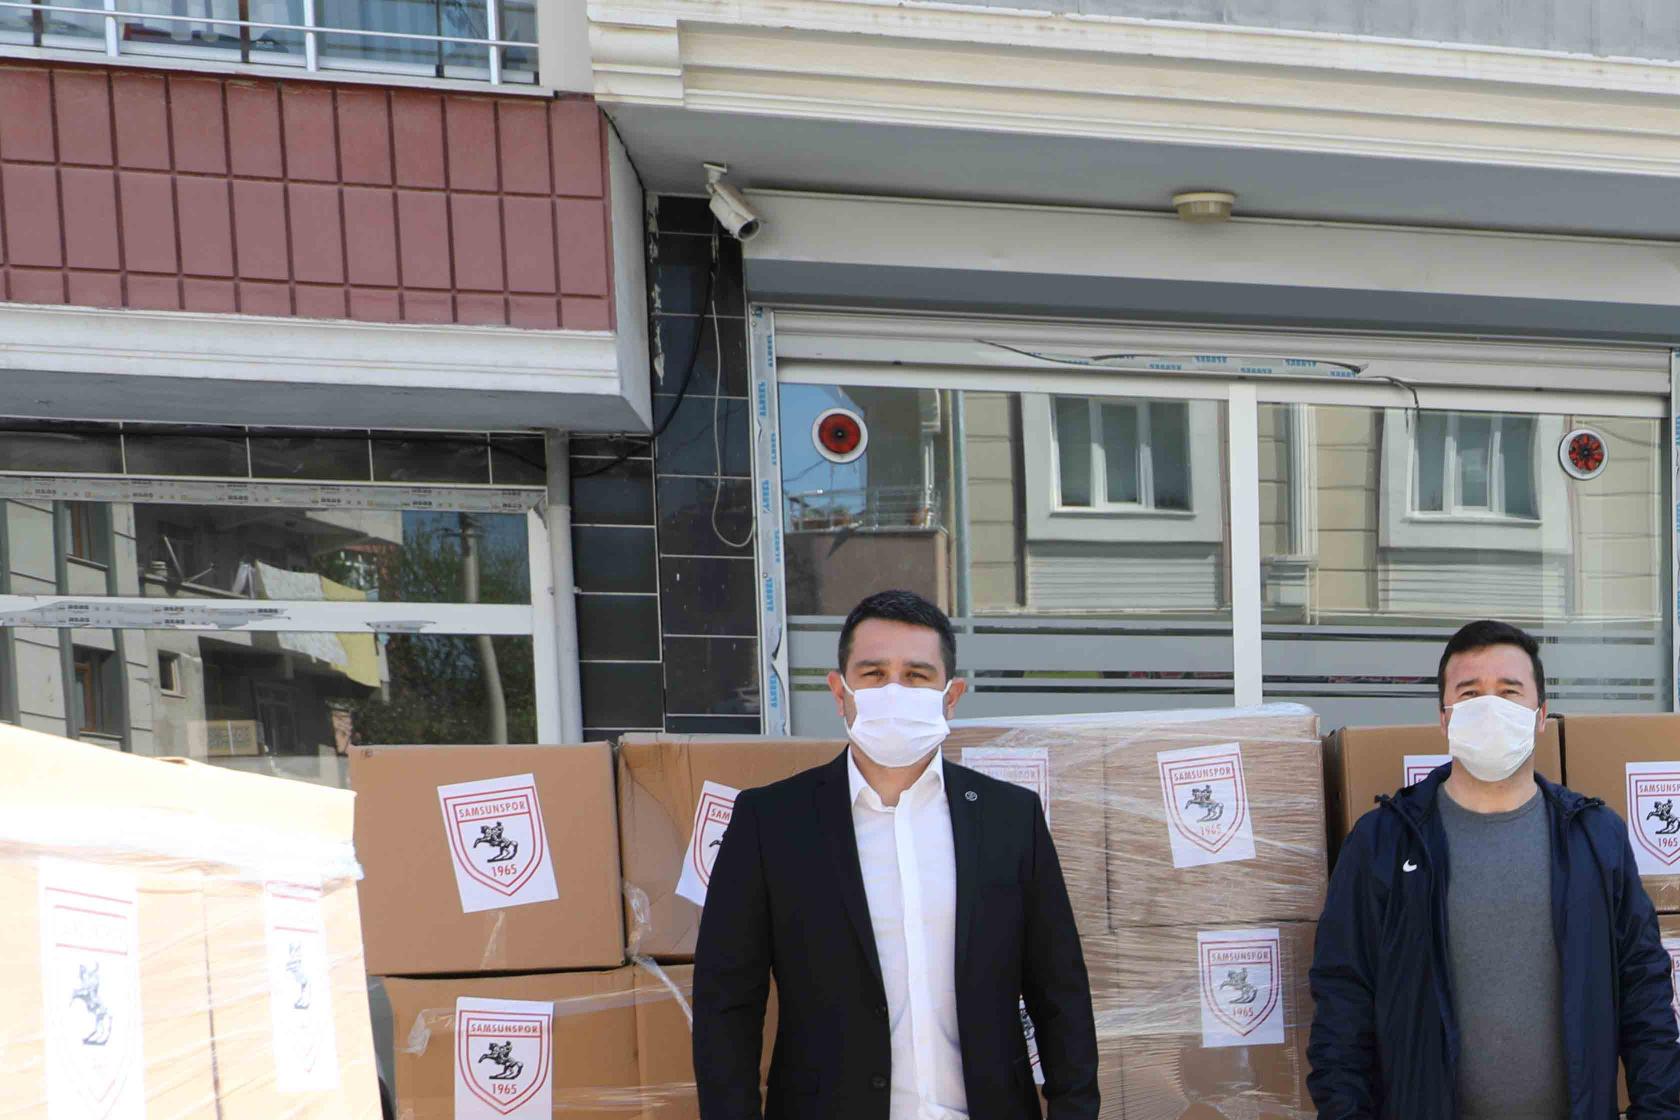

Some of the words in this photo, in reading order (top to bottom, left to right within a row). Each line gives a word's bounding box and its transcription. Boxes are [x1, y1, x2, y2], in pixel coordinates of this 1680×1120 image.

[1174, 766, 1231, 782] SAMSUNSPOR
[458, 801, 526, 819] SAMSUNSPOR
[1657, 837, 1679, 848] 1965
[491, 863, 517, 877] 1965
[1211, 950, 1270, 962] SAMSUNSPOR
[1231, 1006, 1254, 1018] 1965
[471, 1022, 539, 1034] SAMSUNSPOR
[491, 1083, 517, 1095] 1965
